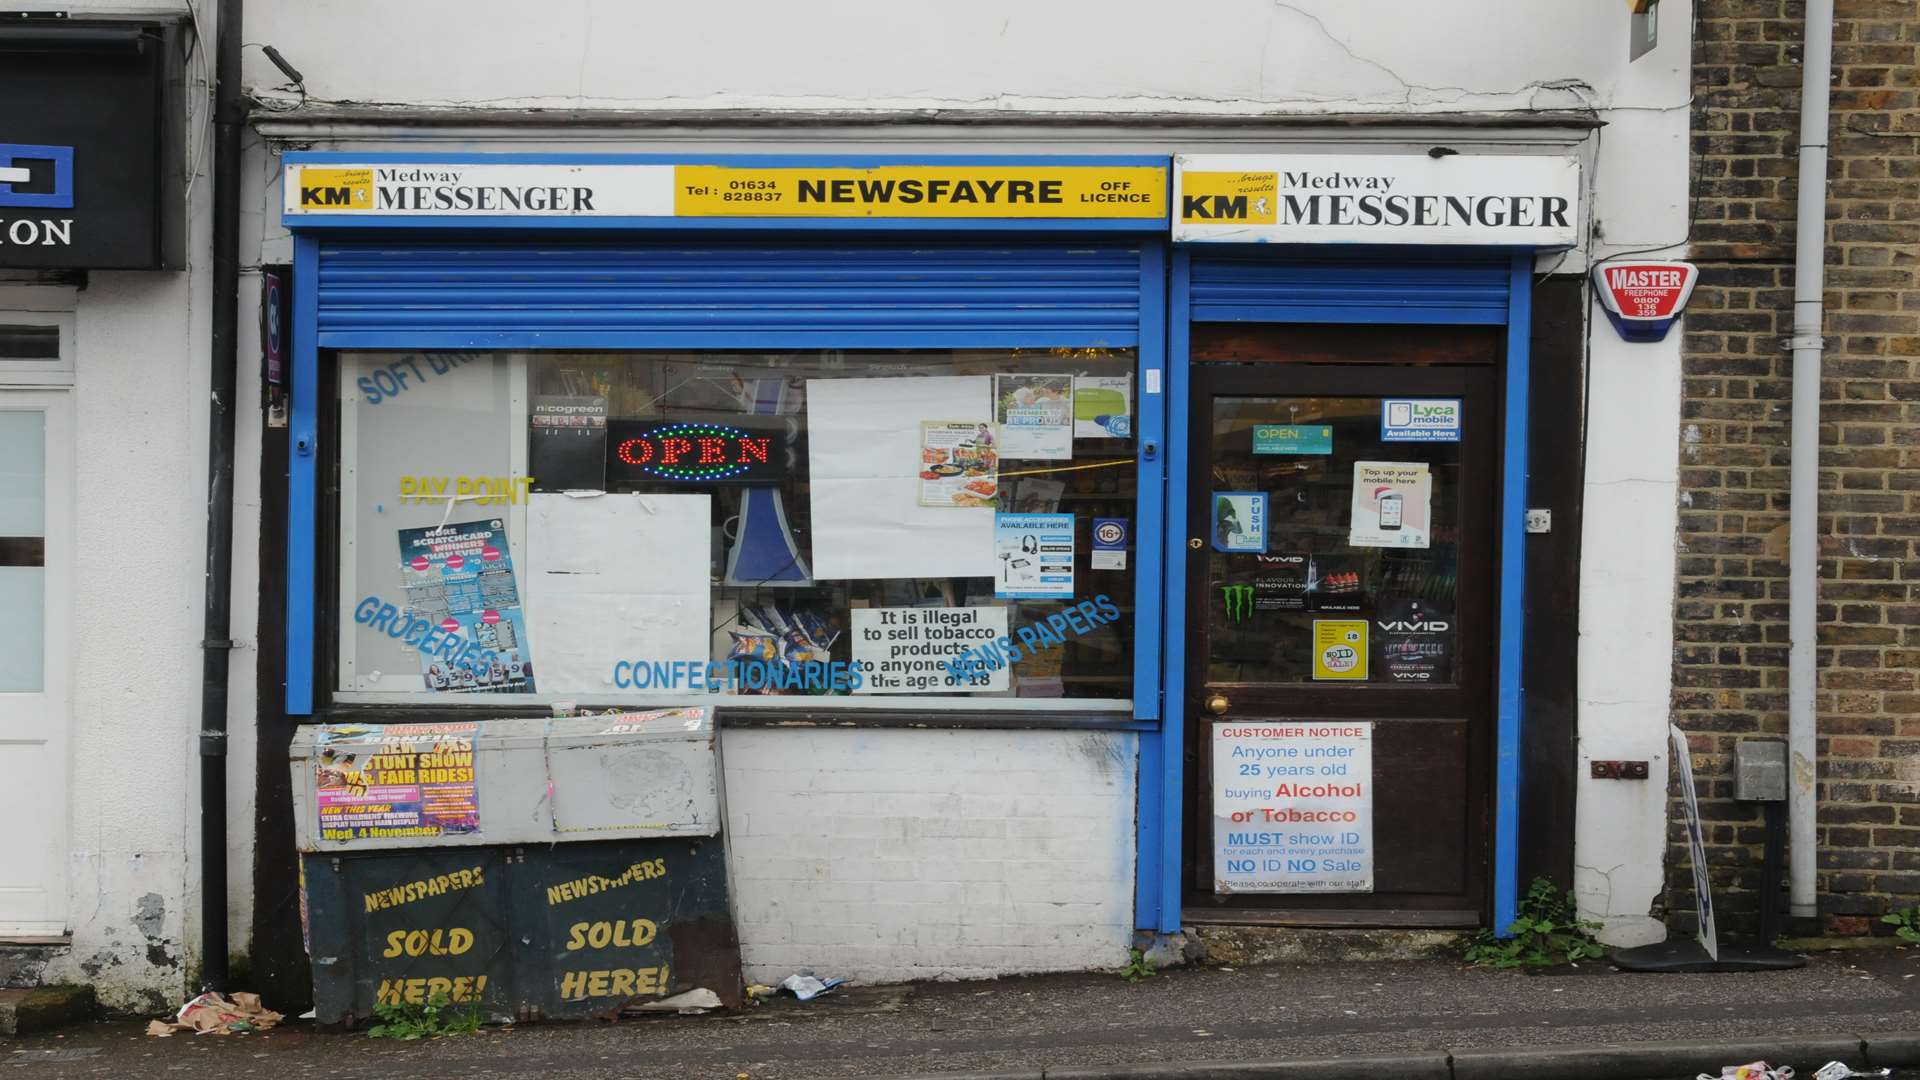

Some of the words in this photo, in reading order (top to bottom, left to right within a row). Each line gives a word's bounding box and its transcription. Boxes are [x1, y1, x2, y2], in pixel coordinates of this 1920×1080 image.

[377, 168, 463, 185] Medway
[1283, 171, 1395, 193] Medway
[729, 180, 777, 191] 01634
[797, 179, 1063, 204] NEWSFAYRE
[1100, 181, 1132, 191] OFF
[301, 186, 351, 205] KM
[377, 186, 596, 211] MESSENGER
[723, 191, 782, 202] 828837
[1080, 193, 1151, 204] LICENCE
[1183, 195, 1248, 219] KM
[1279, 195, 1571, 228] MESSENGER
[0, 219, 74, 246] ON
[1612, 269, 1681, 289] MASTER
[1624, 289, 1669, 297] FREEPHONE
[357, 354, 427, 405] SOFT
[536, 403, 603, 414] nicogreen
[1413, 404, 1454, 417] Lyca
[1413, 416, 1454, 424] mobile
[1257, 428, 1298, 440] OPEN
[618, 438, 772, 465] OPEN
[400, 476, 449, 504] PAY
[456, 476, 535, 505] POINT
[1251, 497, 1261, 532] PUSH
[413, 531, 493, 547] SCRATCHCARD
[425, 527, 457, 538] MORE
[1100, 528, 1119, 539] 16+
[434, 539, 485, 552] WINNERS
[422, 550, 456, 560] THAN
[880, 611, 897, 625] It
[902, 610, 917, 625] is
[922, 610, 977, 628] illegal
[1377, 621, 1449, 631] VIVID
[354, 596, 498, 677] GROCERIES
[863, 627, 882, 641] to
[887, 626, 918, 641] sell
[924, 625, 996, 640] tobacco
[943, 635, 1023, 682] NEWS
[1016, 594, 1121, 655] PAPERS
[890, 641, 970, 659] products
[614, 659, 865, 690] CONFECTIONARIES
[856, 659, 875, 672] to
[880, 659, 946, 676] anyone
[871, 673, 901, 688] the
[906, 675, 938, 690] age
[944, 672, 963, 686] of
[969, 672, 991, 686] 18
[1222, 728, 1304, 738] CUSTOMER
[1309, 727, 1364, 737] NOTICE
[1231, 745, 1298, 760] Anyone
[1304, 745, 1355, 758] under
[363, 754, 416, 771] STUNT
[419, 752, 472, 768] SHOW
[379, 769, 416, 785] FAIR
[419, 767, 474, 784] RIDES!
[1239, 764, 1261, 776] 25
[1266, 765, 1315, 778] years
[1320, 763, 1347, 776] old
[1225, 788, 1271, 800] buying
[1275, 783, 1361, 797] Alcohol
[320, 805, 343, 814] NEW
[345, 805, 366, 814] THIS
[368, 804, 392, 813] YEAR
[1231, 811, 1254, 823] or
[1261, 808, 1356, 823] Tobacco
[321, 813, 343, 822] EXTRA
[321, 820, 348, 829] DISPLAY
[374, 819, 391, 827] MAIN
[358, 827, 368, 839] 4
[370, 826, 441, 838] November
[1228, 832, 1283, 845] MUST
[1289, 832, 1333, 845] show
[1341, 832, 1360, 845] ID
[1223, 847, 1236, 855] for
[1237, 847, 1264, 855] each
[1267, 847, 1286, 855] and
[1288, 848, 1316, 857] every
[1318, 847, 1365, 857] purchase
[1227, 859, 1256, 872] NO
[1263, 859, 1281, 872] ID
[1287, 859, 1316, 872] NO
[1322, 859, 1361, 872] Sale
[363, 865, 485, 913] NEWSPAPERS
[1225, 880, 1257, 889] Please
[1307, 879, 1327, 888] with
[1328, 880, 1345, 888] our
[383, 927, 474, 958] SOLD
[566, 918, 657, 951] SOLD
[376, 975, 488, 1006] HERE!
[560, 965, 671, 1000] HERE!
